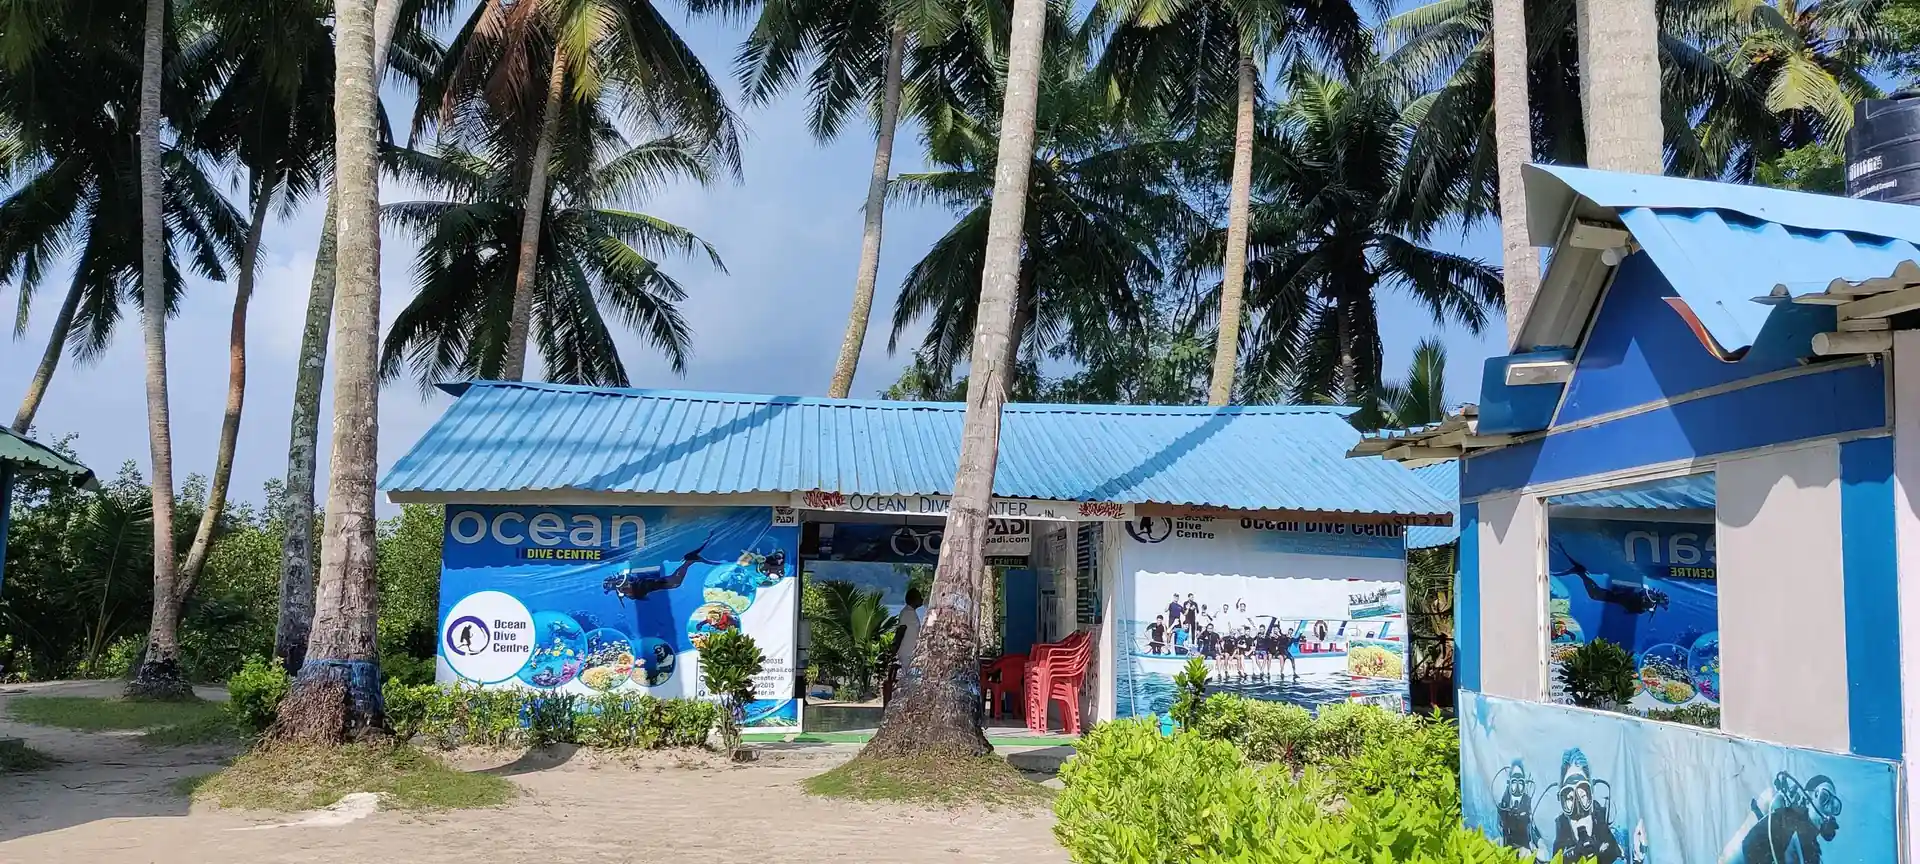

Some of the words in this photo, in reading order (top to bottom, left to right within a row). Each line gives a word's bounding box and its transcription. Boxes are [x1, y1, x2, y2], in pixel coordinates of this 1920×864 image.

[850, 493, 907, 512] OCEAN
[990, 502, 1027, 516] NTER
[450, 510, 646, 547] ocean
[987, 519, 1030, 535] PADI
[1176, 521, 1202, 530] Dive
[1351, 523, 1404, 537] Centr
[1176, 530, 1215, 539] Centre
[527, 548, 553, 559] DIVE
[556, 549, 601, 560] CENTRE
[494, 619, 526, 629] Ocean
[493, 631, 516, 641] Dive
[493, 642, 529, 652] Centre
